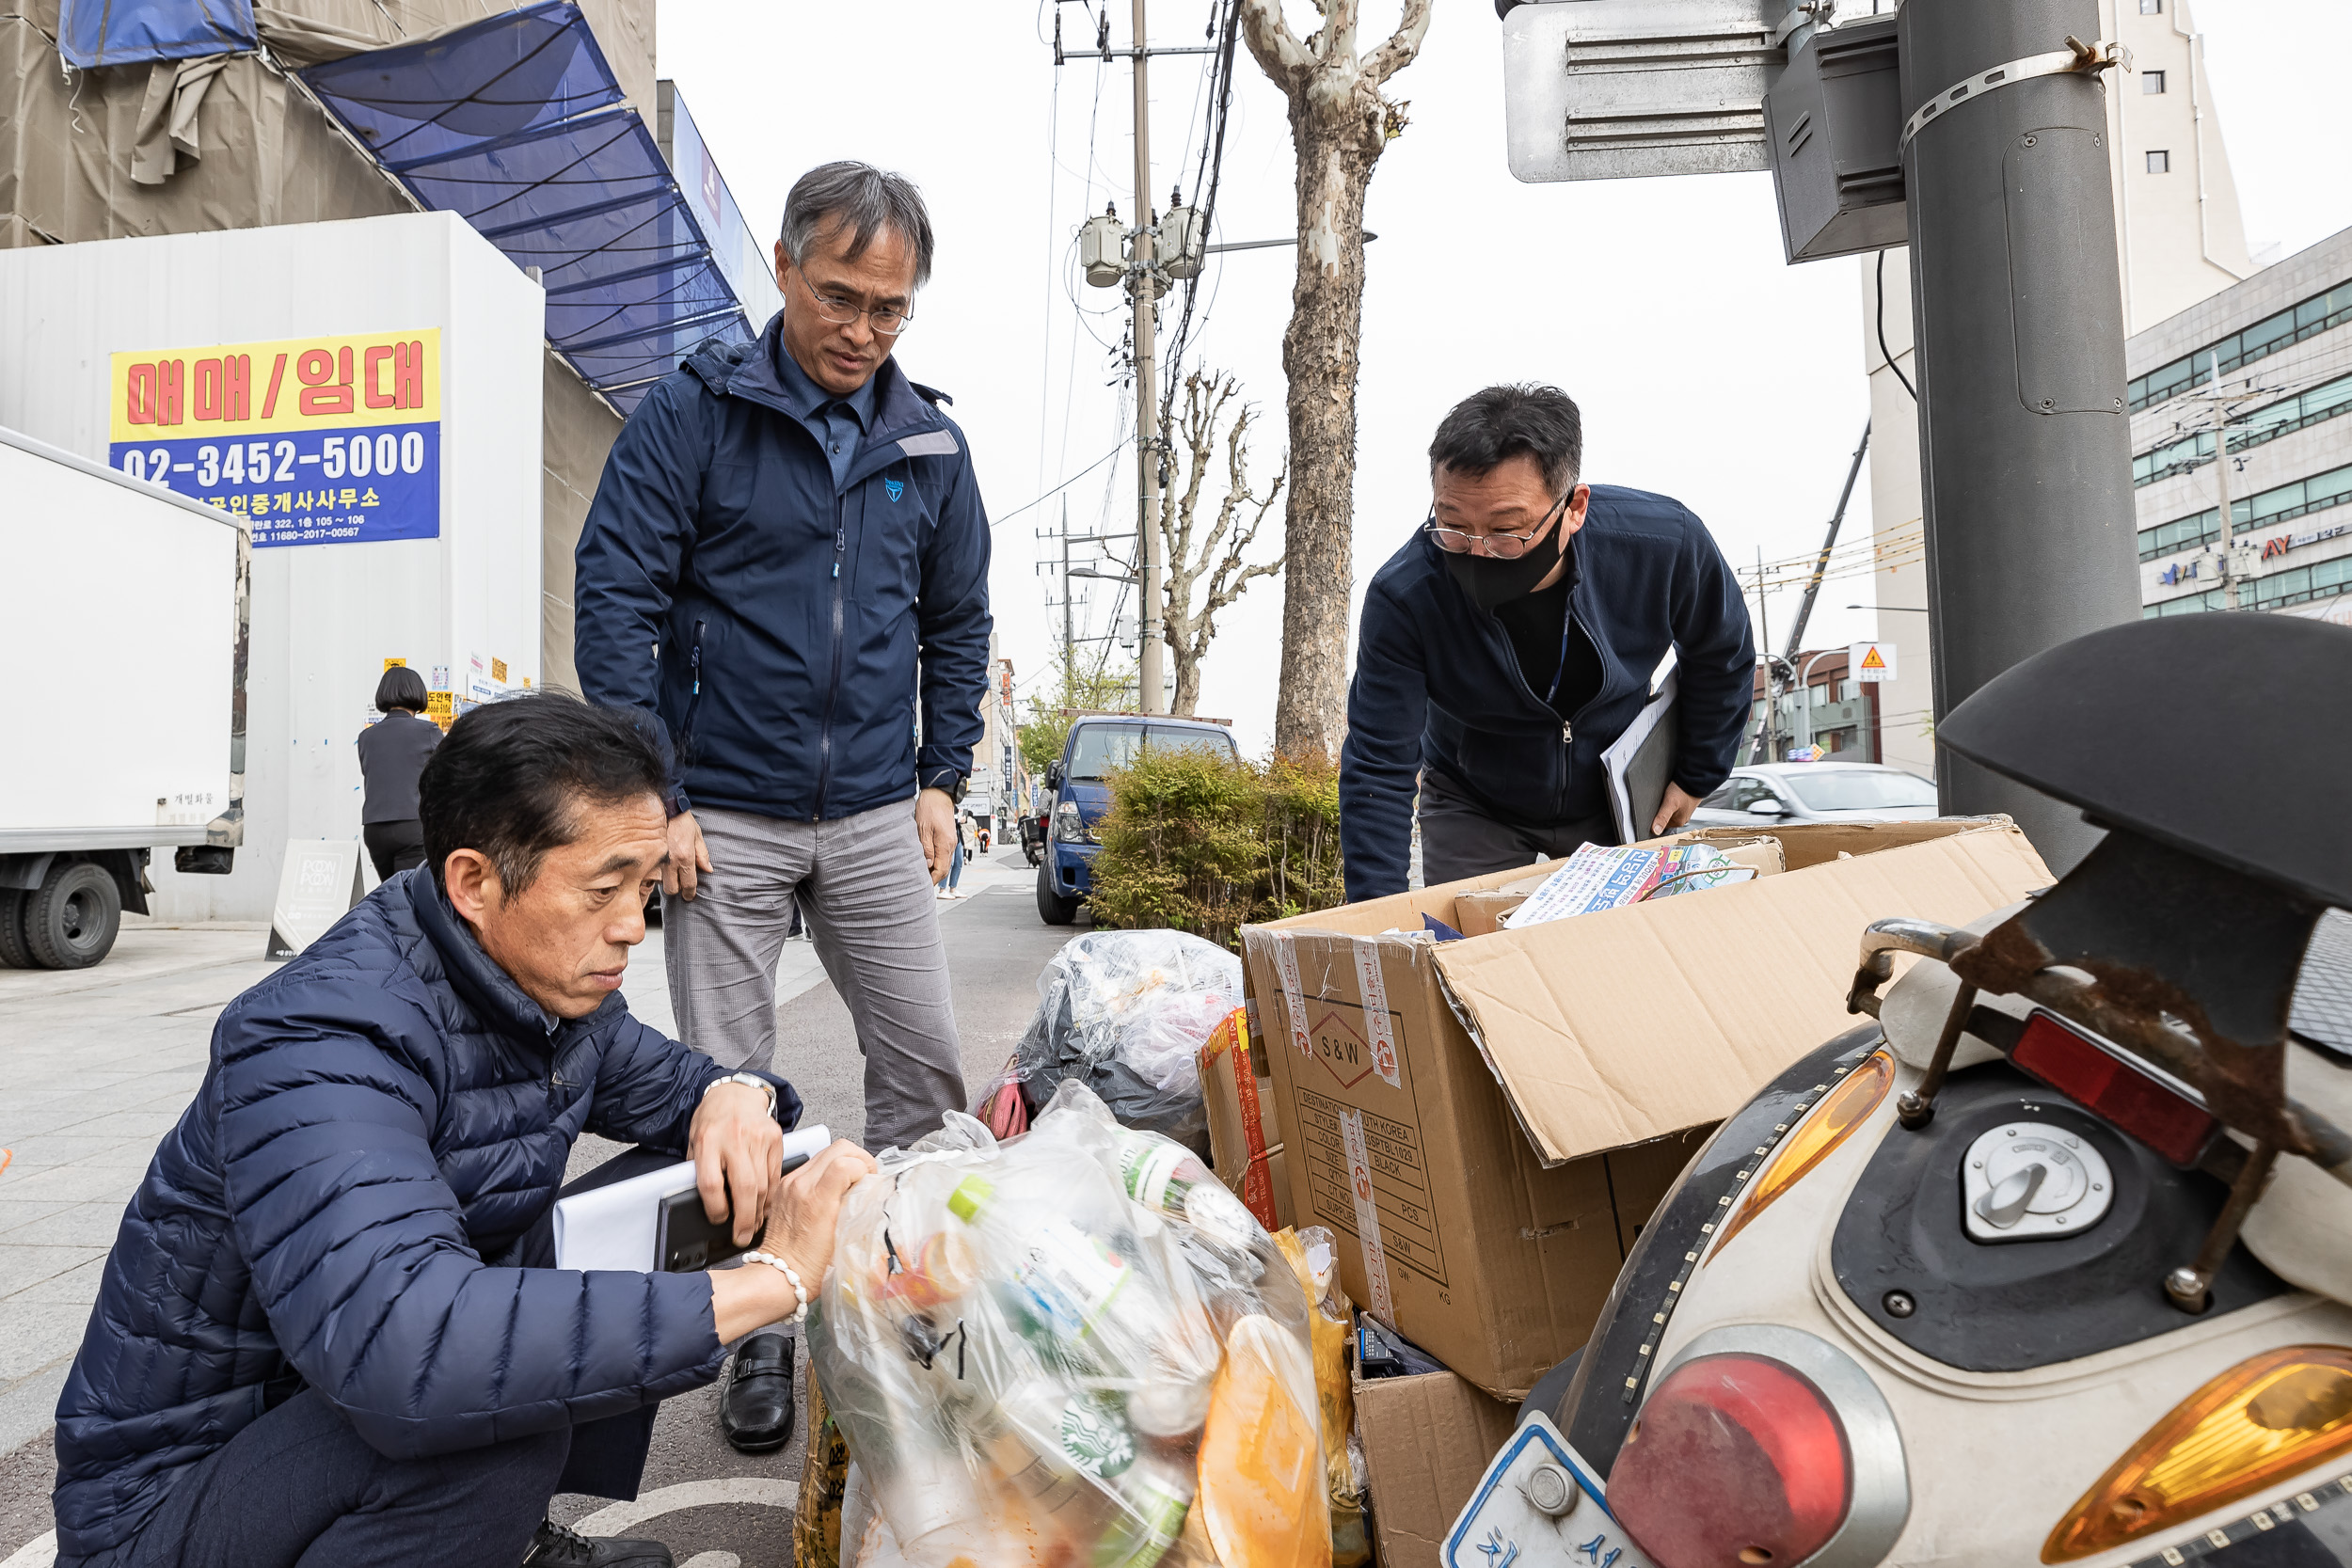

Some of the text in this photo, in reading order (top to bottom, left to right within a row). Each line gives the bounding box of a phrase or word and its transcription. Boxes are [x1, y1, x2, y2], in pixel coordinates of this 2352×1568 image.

[126, 340, 423, 426] 매매/임대
[123, 430, 424, 488] 02-3452-5000
[315, 516, 332, 527] 105
[347, 515, 365, 525] 106
[1379, 1120, 1409, 1142] KOREA
[1375, 1155, 1402, 1176] BLACK
[1401, 1204, 1420, 1222] PCS
[1438, 1290, 1452, 1306] KG
